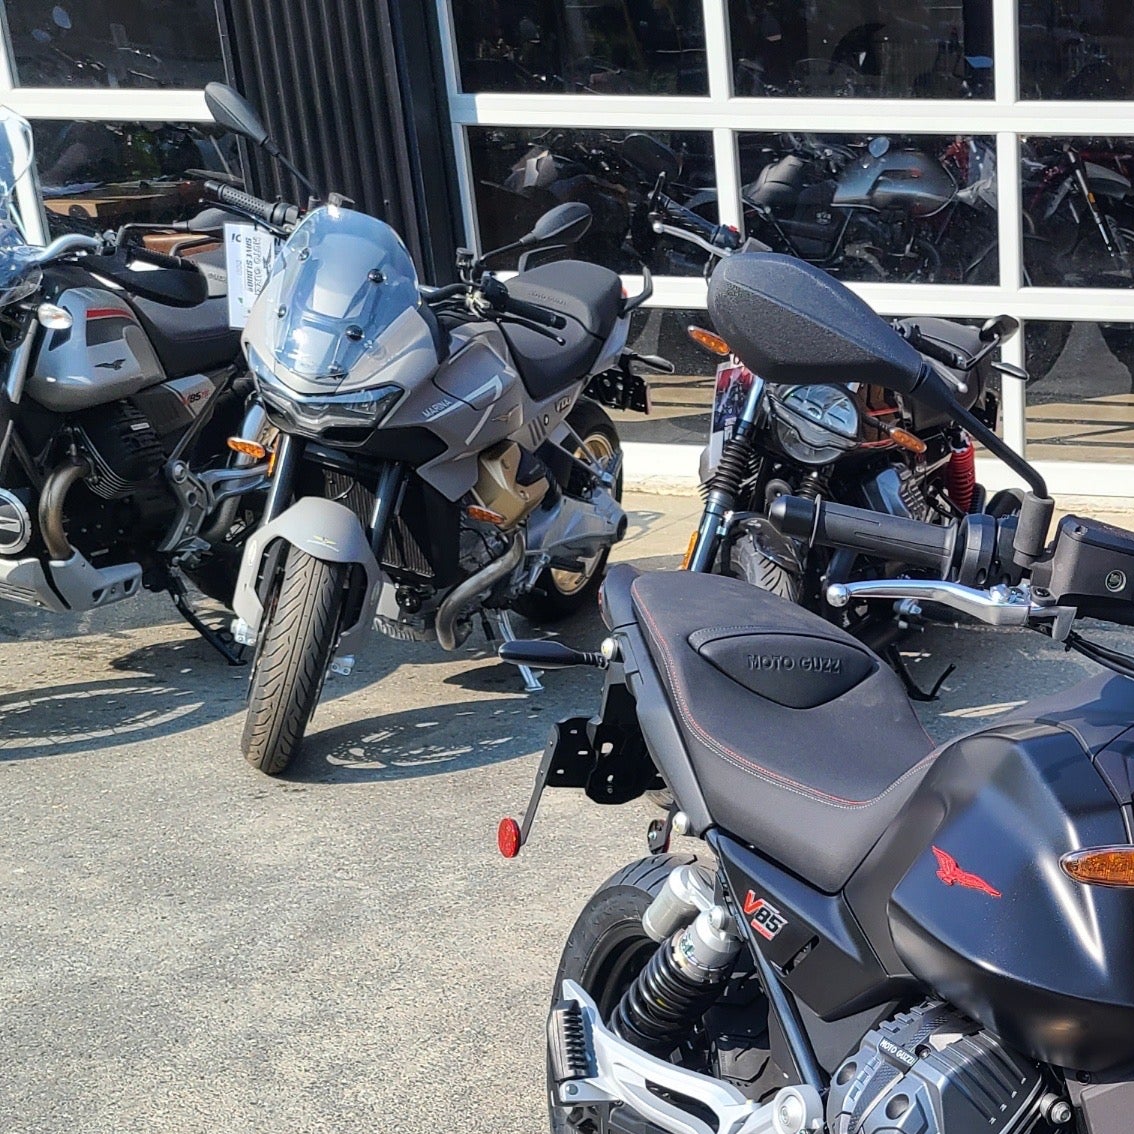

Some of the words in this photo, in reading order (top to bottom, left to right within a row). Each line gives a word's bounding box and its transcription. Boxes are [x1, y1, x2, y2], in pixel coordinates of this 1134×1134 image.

[422, 399, 453, 418] MARINA
[747, 654, 795, 671] MOTO
[743, 889, 788, 934] V85
[880, 1039, 898, 1054] MOTO
[895, 1050, 915, 1066] GUZZI
